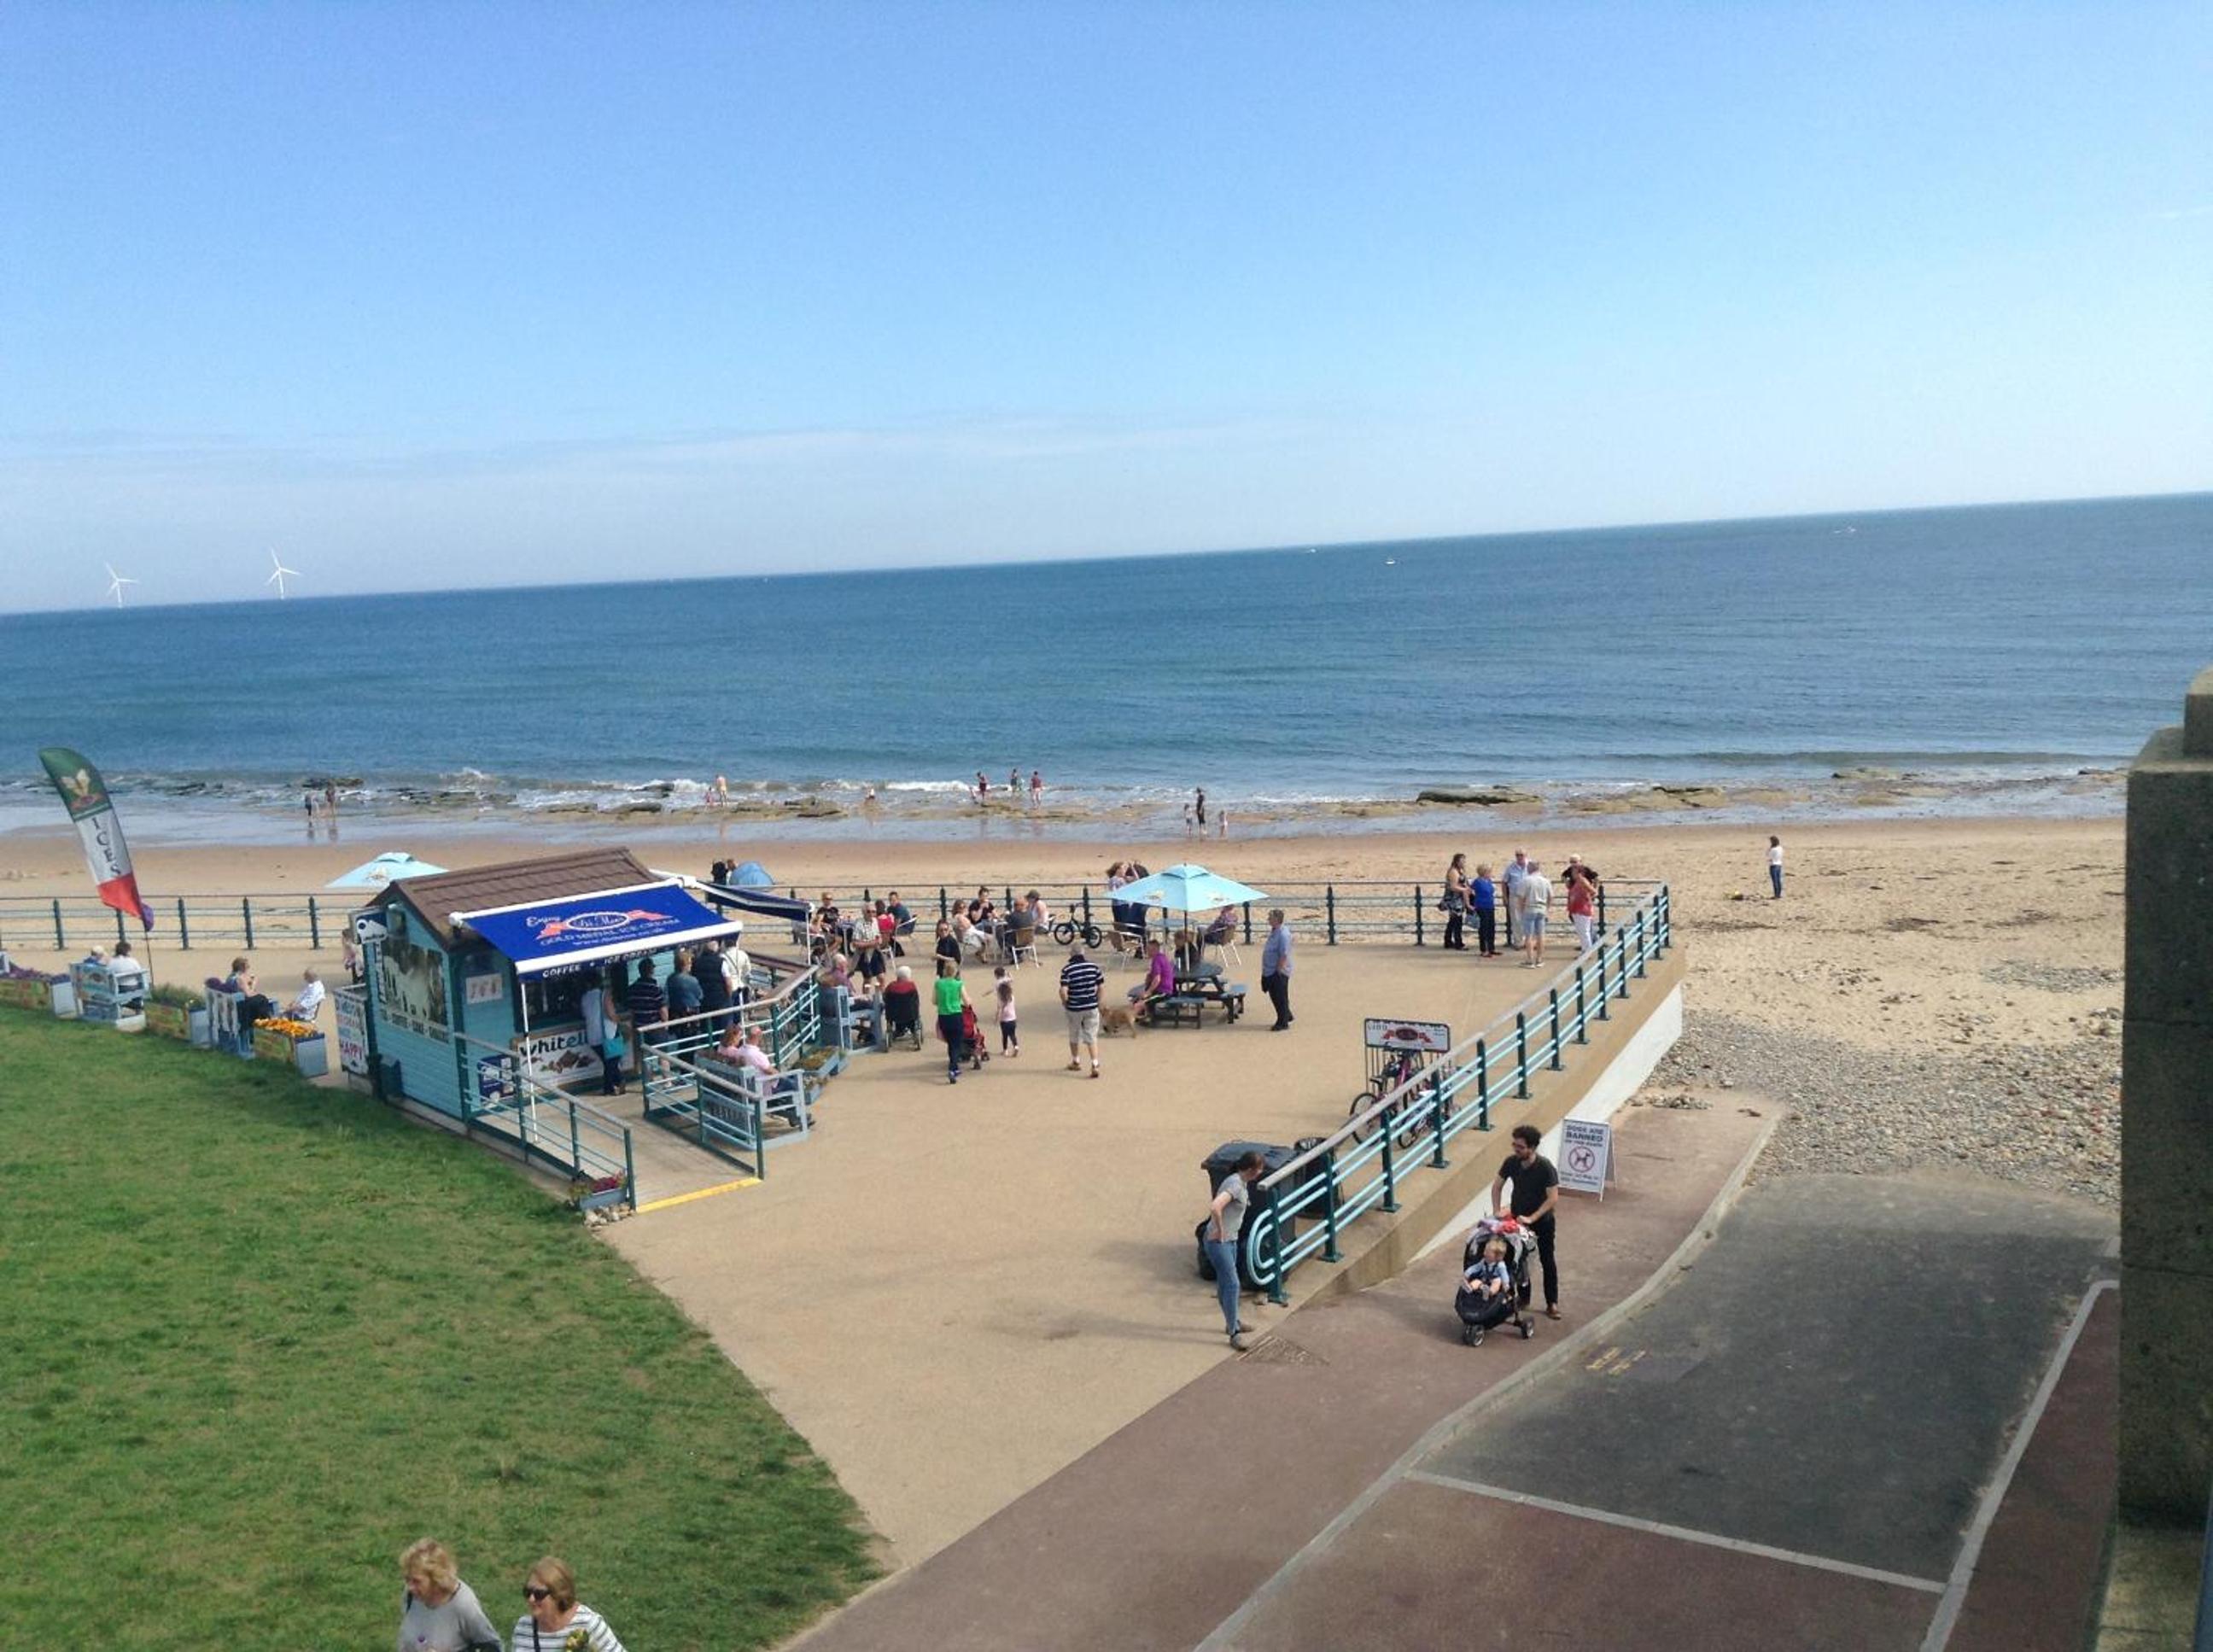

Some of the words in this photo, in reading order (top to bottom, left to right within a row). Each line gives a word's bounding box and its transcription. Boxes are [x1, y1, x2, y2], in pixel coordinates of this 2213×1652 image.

[91, 816, 121, 874] ICES
[542, 964, 581, 978] COFFEE
[1567, 1131, 1603, 1141] BANNED
